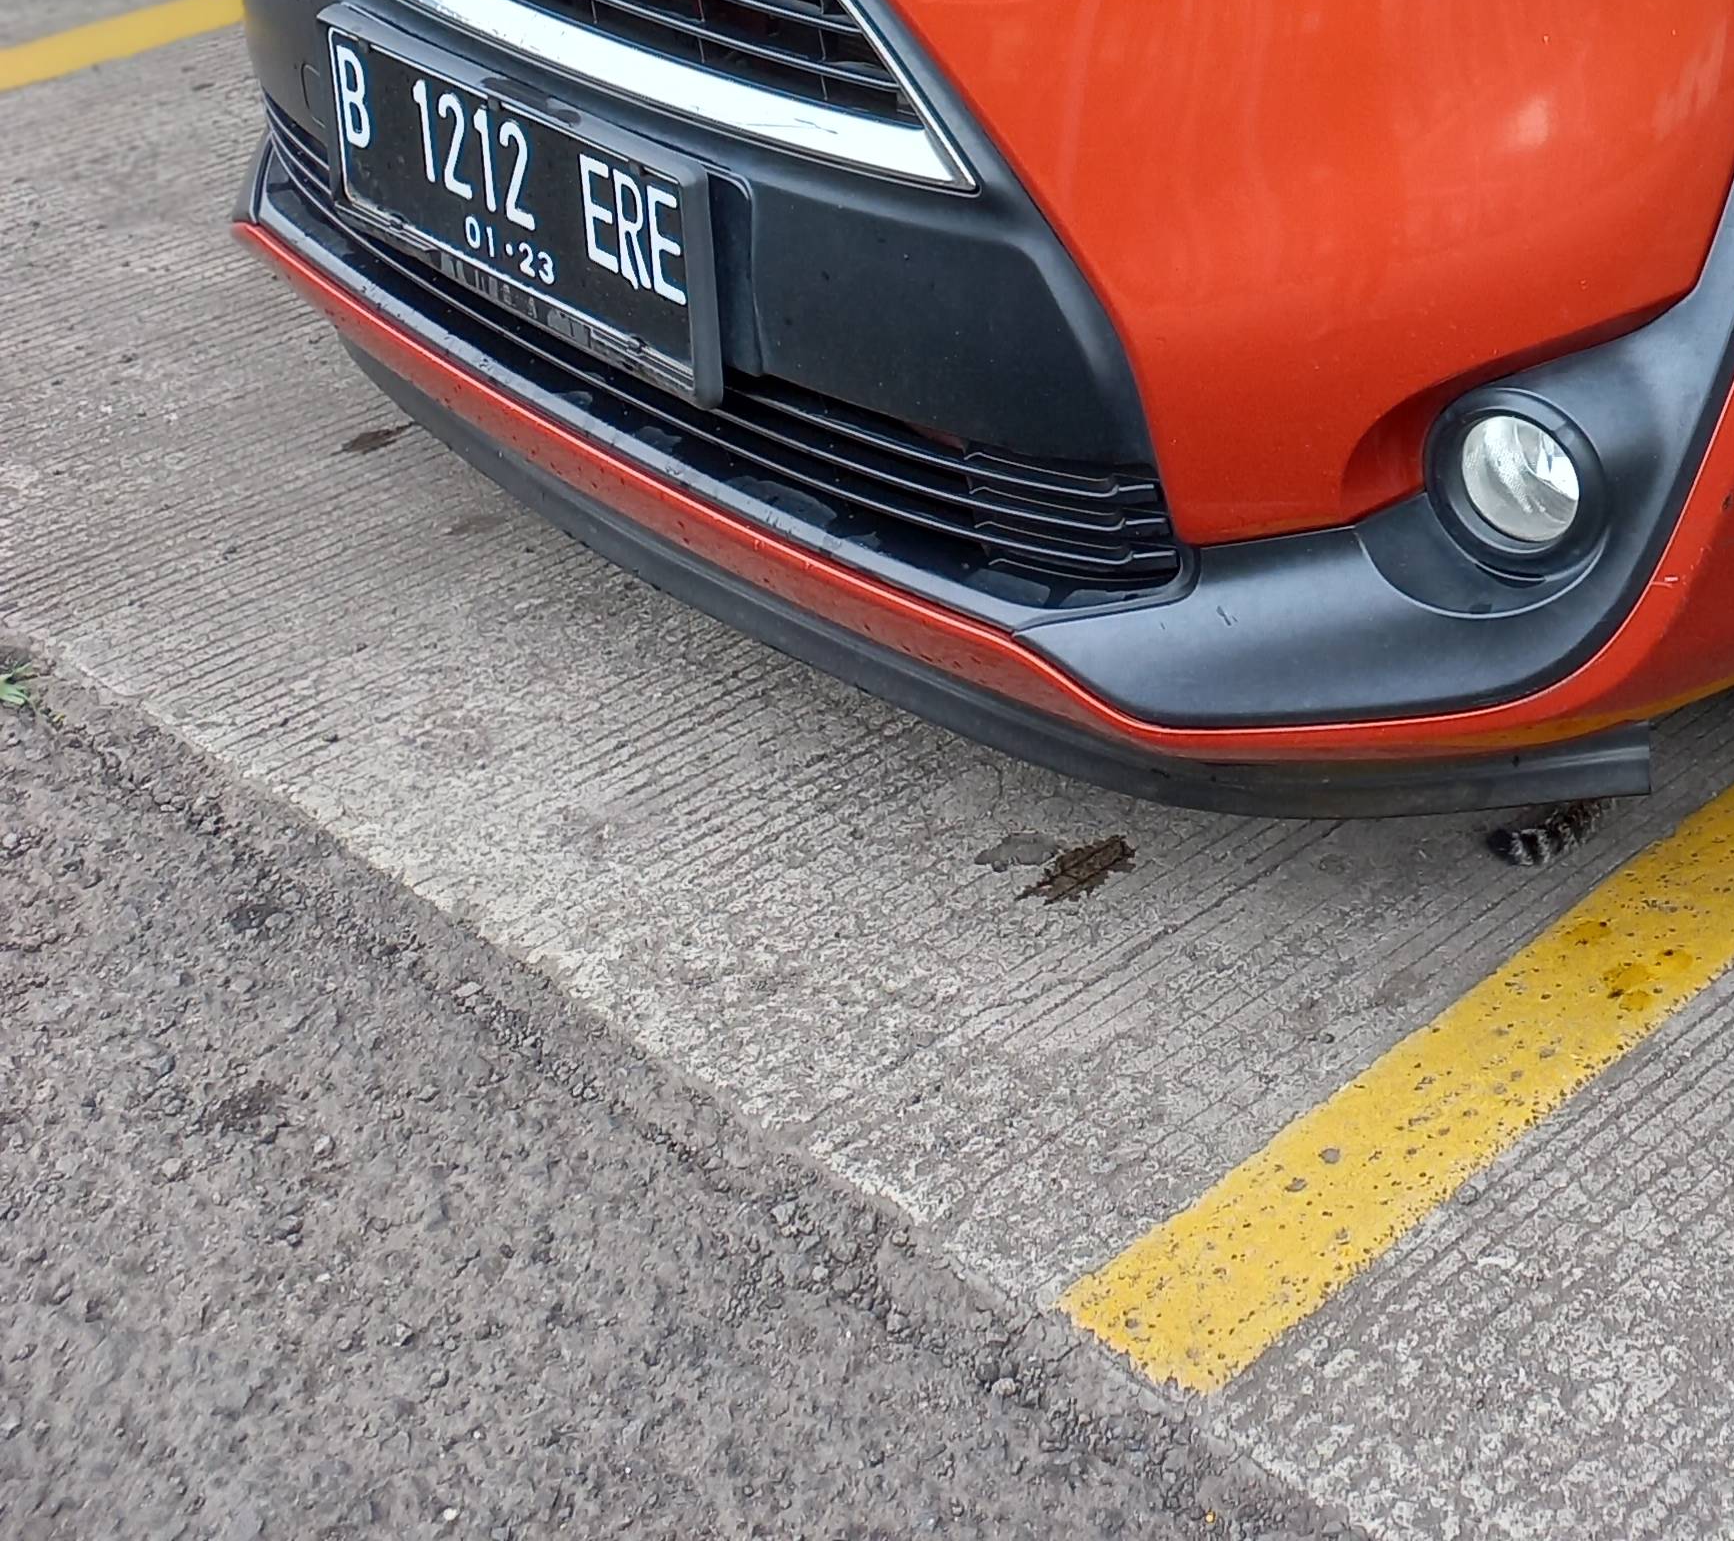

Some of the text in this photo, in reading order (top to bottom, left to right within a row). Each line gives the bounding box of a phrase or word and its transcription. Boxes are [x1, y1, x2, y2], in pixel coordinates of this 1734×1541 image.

[336, 44, 371, 148] B
[412, 79, 536, 231] 1212
[579, 153, 687, 306] ERE
